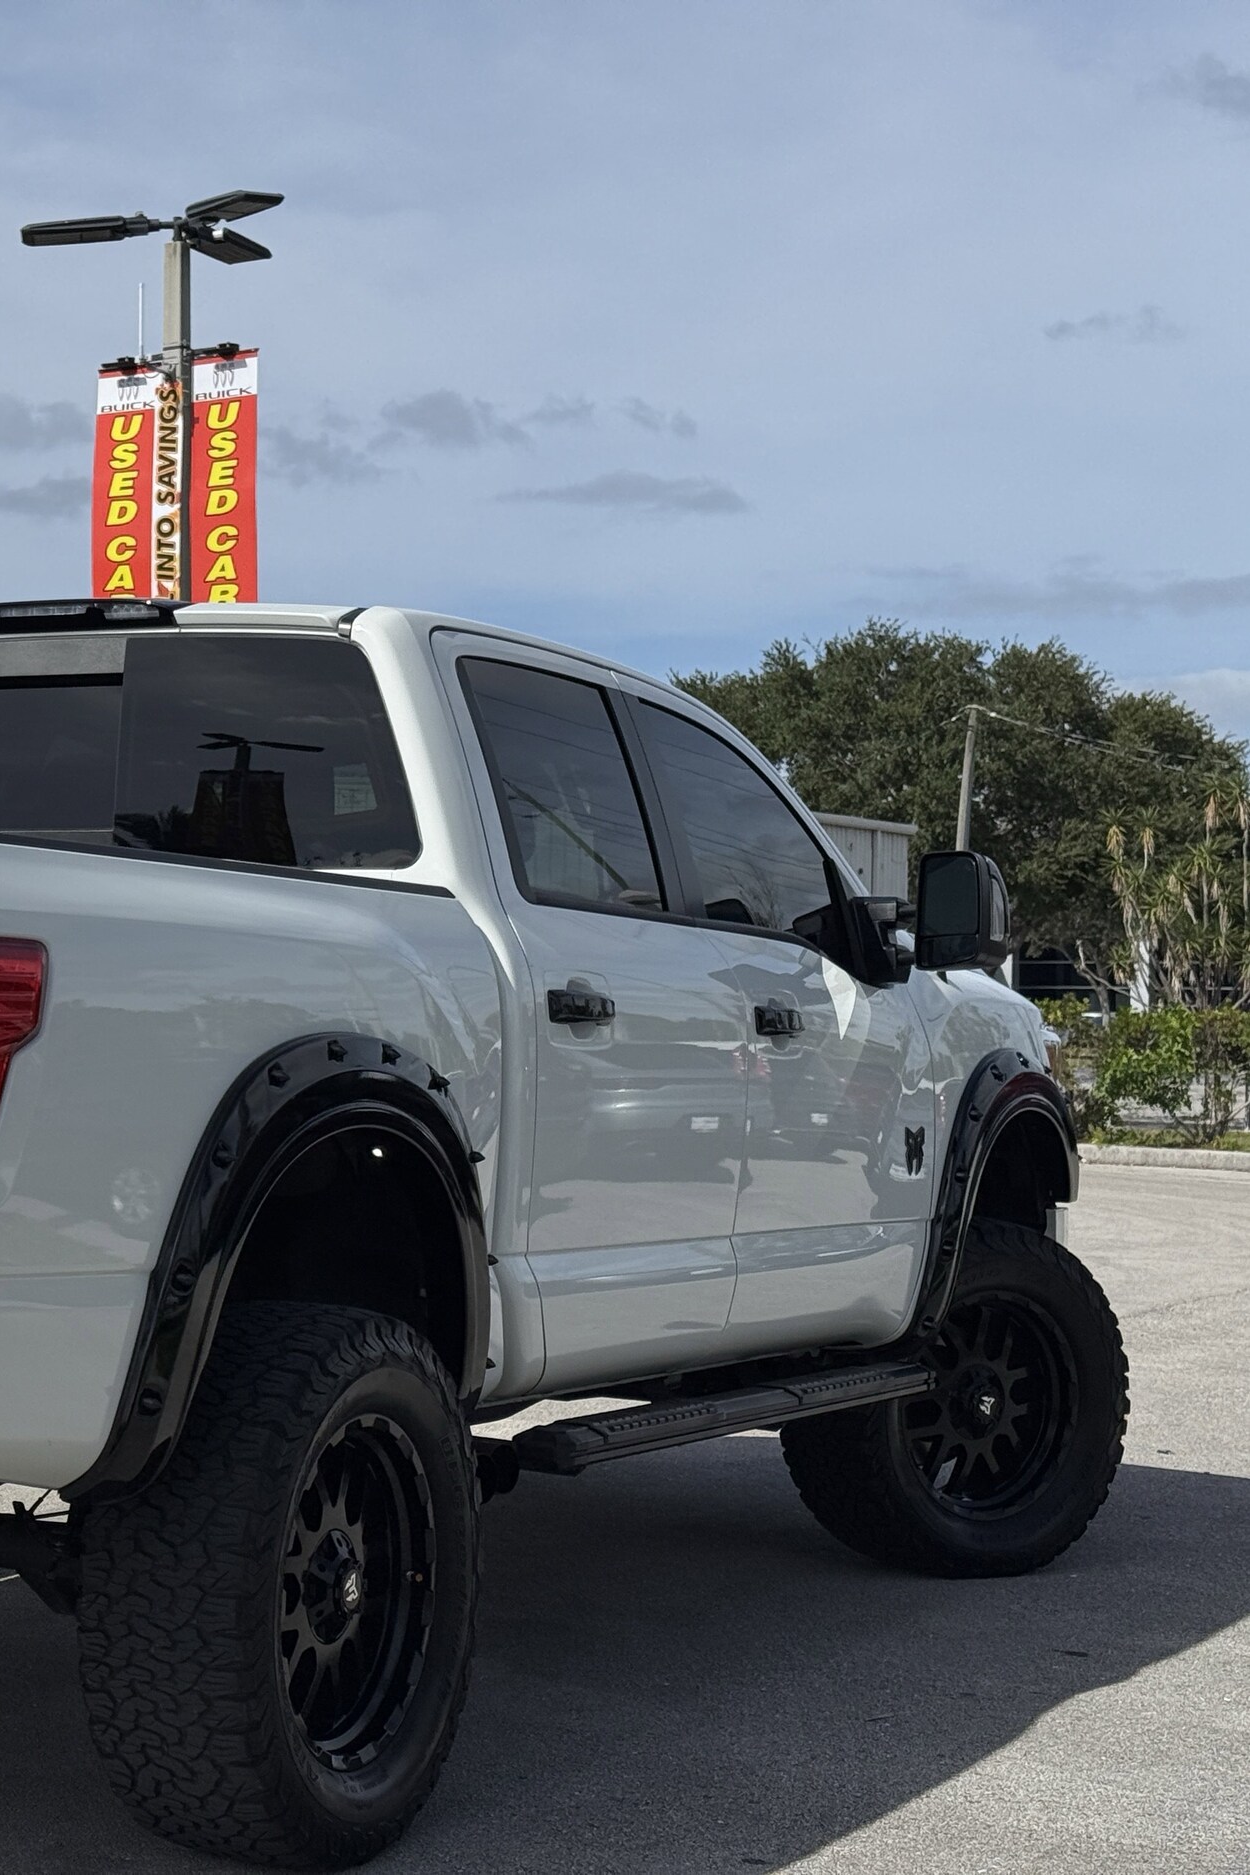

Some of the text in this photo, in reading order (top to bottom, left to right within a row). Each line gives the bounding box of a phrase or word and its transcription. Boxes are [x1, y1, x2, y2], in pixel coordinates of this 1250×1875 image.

[101, 400, 155, 413] BUICK
[195, 386, 252, 400] BUICK
[156, 387, 179, 506] SAVINGS
[204, 399, 241, 517] USED
[104, 413, 144, 599] USED CA
[156, 516, 176, 581] INTO
